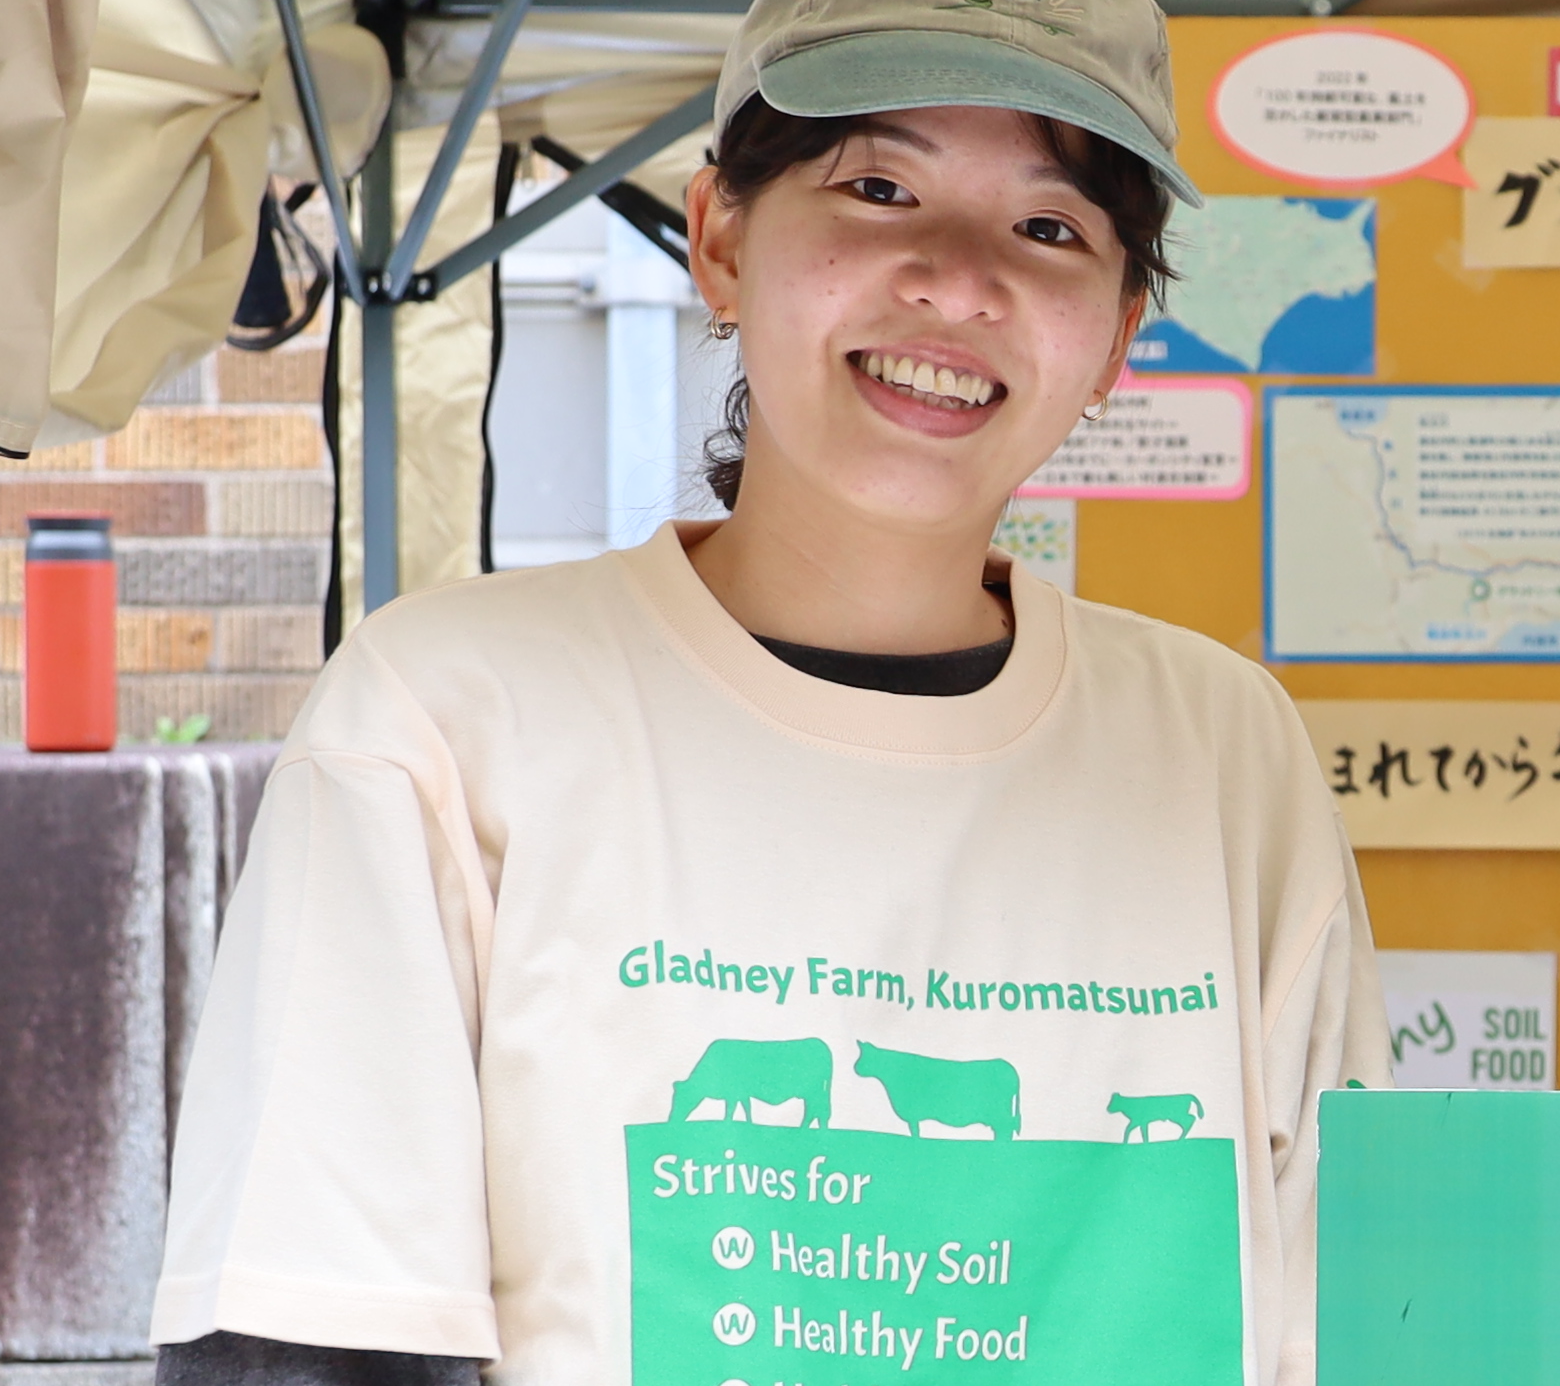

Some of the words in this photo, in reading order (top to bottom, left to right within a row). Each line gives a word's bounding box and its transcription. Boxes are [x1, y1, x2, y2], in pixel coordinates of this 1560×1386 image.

[619, 940, 794, 1004] Gladney
[806, 957, 916, 1011] Farm,
[926, 969, 1218, 1016] Kuromatsunai
[1484, 1007, 1546, 1040] SOIL
[1471, 1048, 1546, 1082] FOOD
[652, 1149, 796, 1202] Strives
[807, 1155, 871, 1205] for
[771, 1229, 928, 1294] Healthy
[936, 1240, 1011, 1287] Soil
[773, 1304, 924, 1371] Healthy
[935, 1315, 1028, 1362] Food
